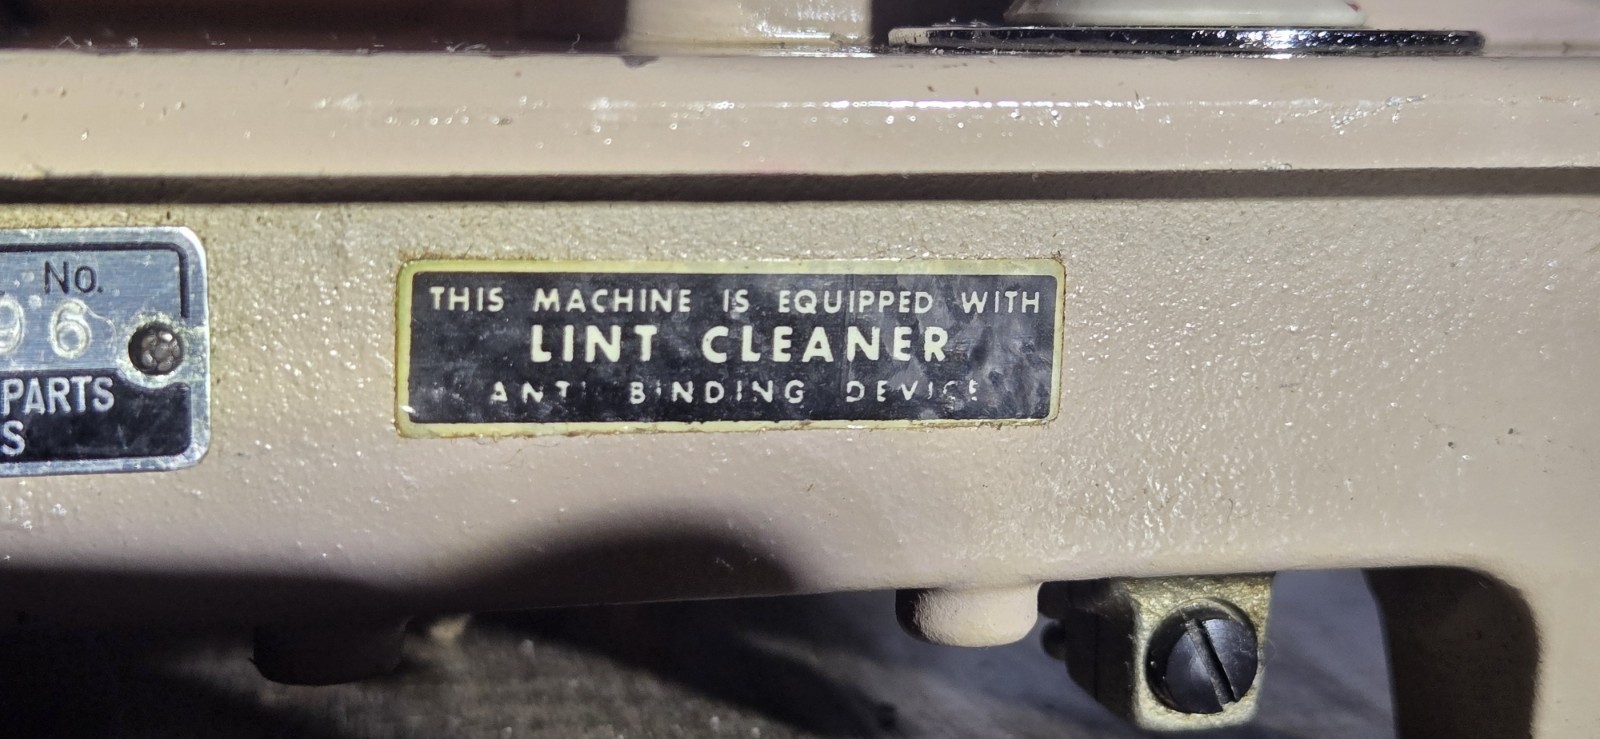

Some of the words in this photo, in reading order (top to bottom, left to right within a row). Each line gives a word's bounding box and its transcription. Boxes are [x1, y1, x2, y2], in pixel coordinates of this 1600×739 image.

[44, 261, 103, 293] No.
[429, 286, 504, 312] THIS
[533, 288, 692, 313] MACHINE
[722, 288, 749, 313] IS
[778, 289, 934, 314] EQUIPPED
[961, 291, 1040, 314] WITH
[530, 324, 658, 363] LINT
[702, 325, 949, 363] CLEANER
[2, 375, 115, 416] PARTS
[1, 420, 25, 456] S
